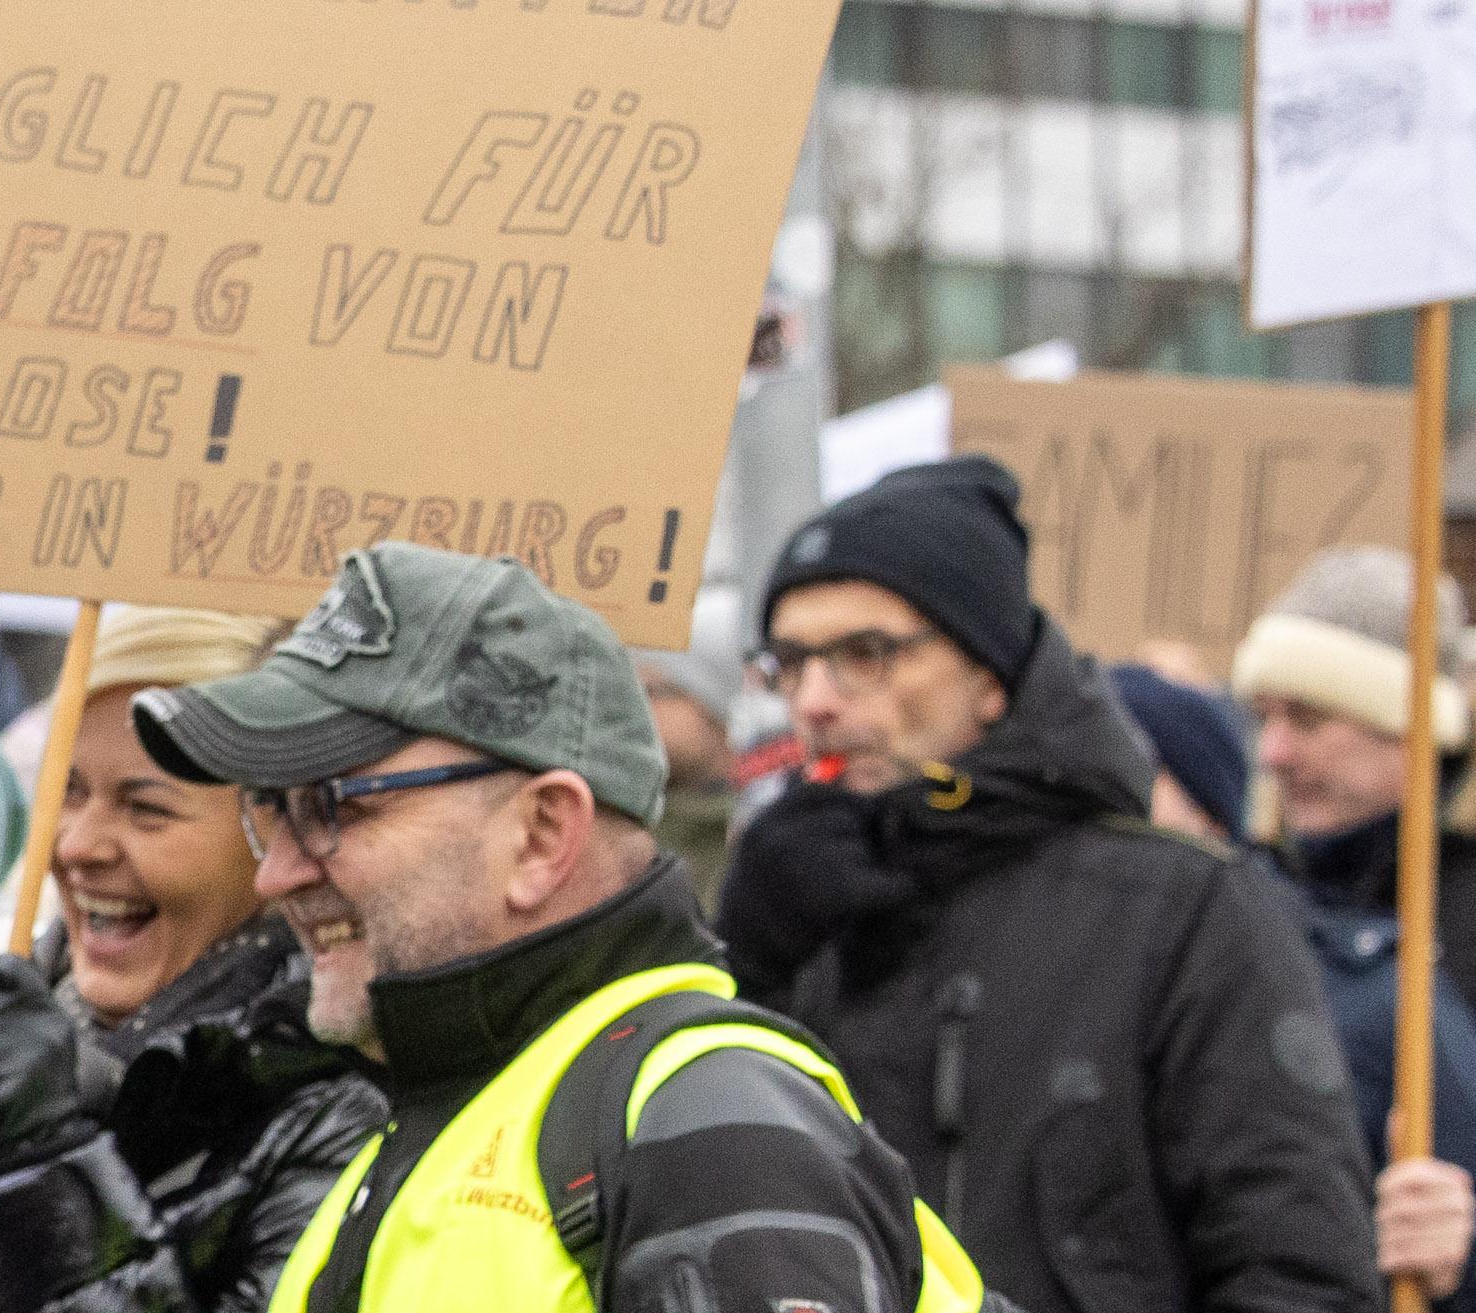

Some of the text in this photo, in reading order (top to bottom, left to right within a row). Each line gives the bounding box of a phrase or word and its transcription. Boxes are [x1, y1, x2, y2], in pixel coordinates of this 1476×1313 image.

[423, 88, 702, 247] FÜR
[309, 242, 570, 373] VON
[31, 472, 130, 569] IN
